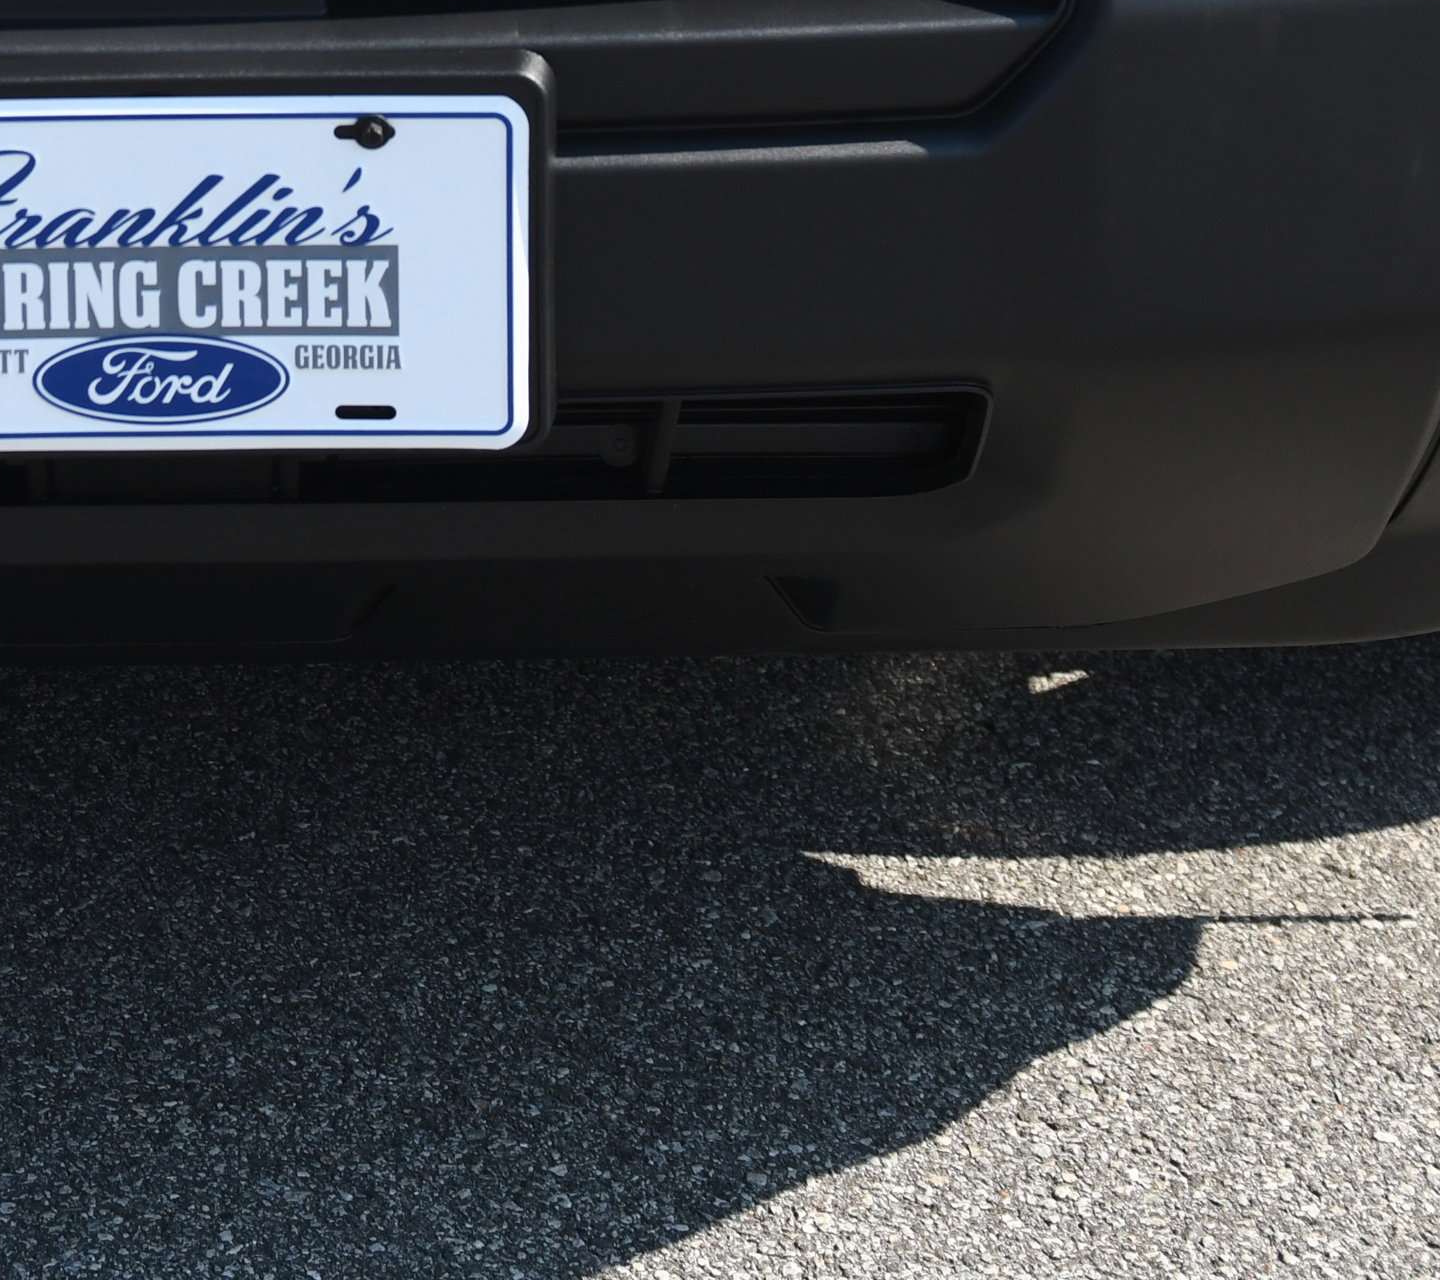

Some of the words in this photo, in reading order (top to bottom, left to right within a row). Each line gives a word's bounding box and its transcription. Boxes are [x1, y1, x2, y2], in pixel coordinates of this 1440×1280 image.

[177, 258, 393, 329] CREEK
[86, 346, 235, 406] Ford
[294, 344, 403, 371] GEORGIA
